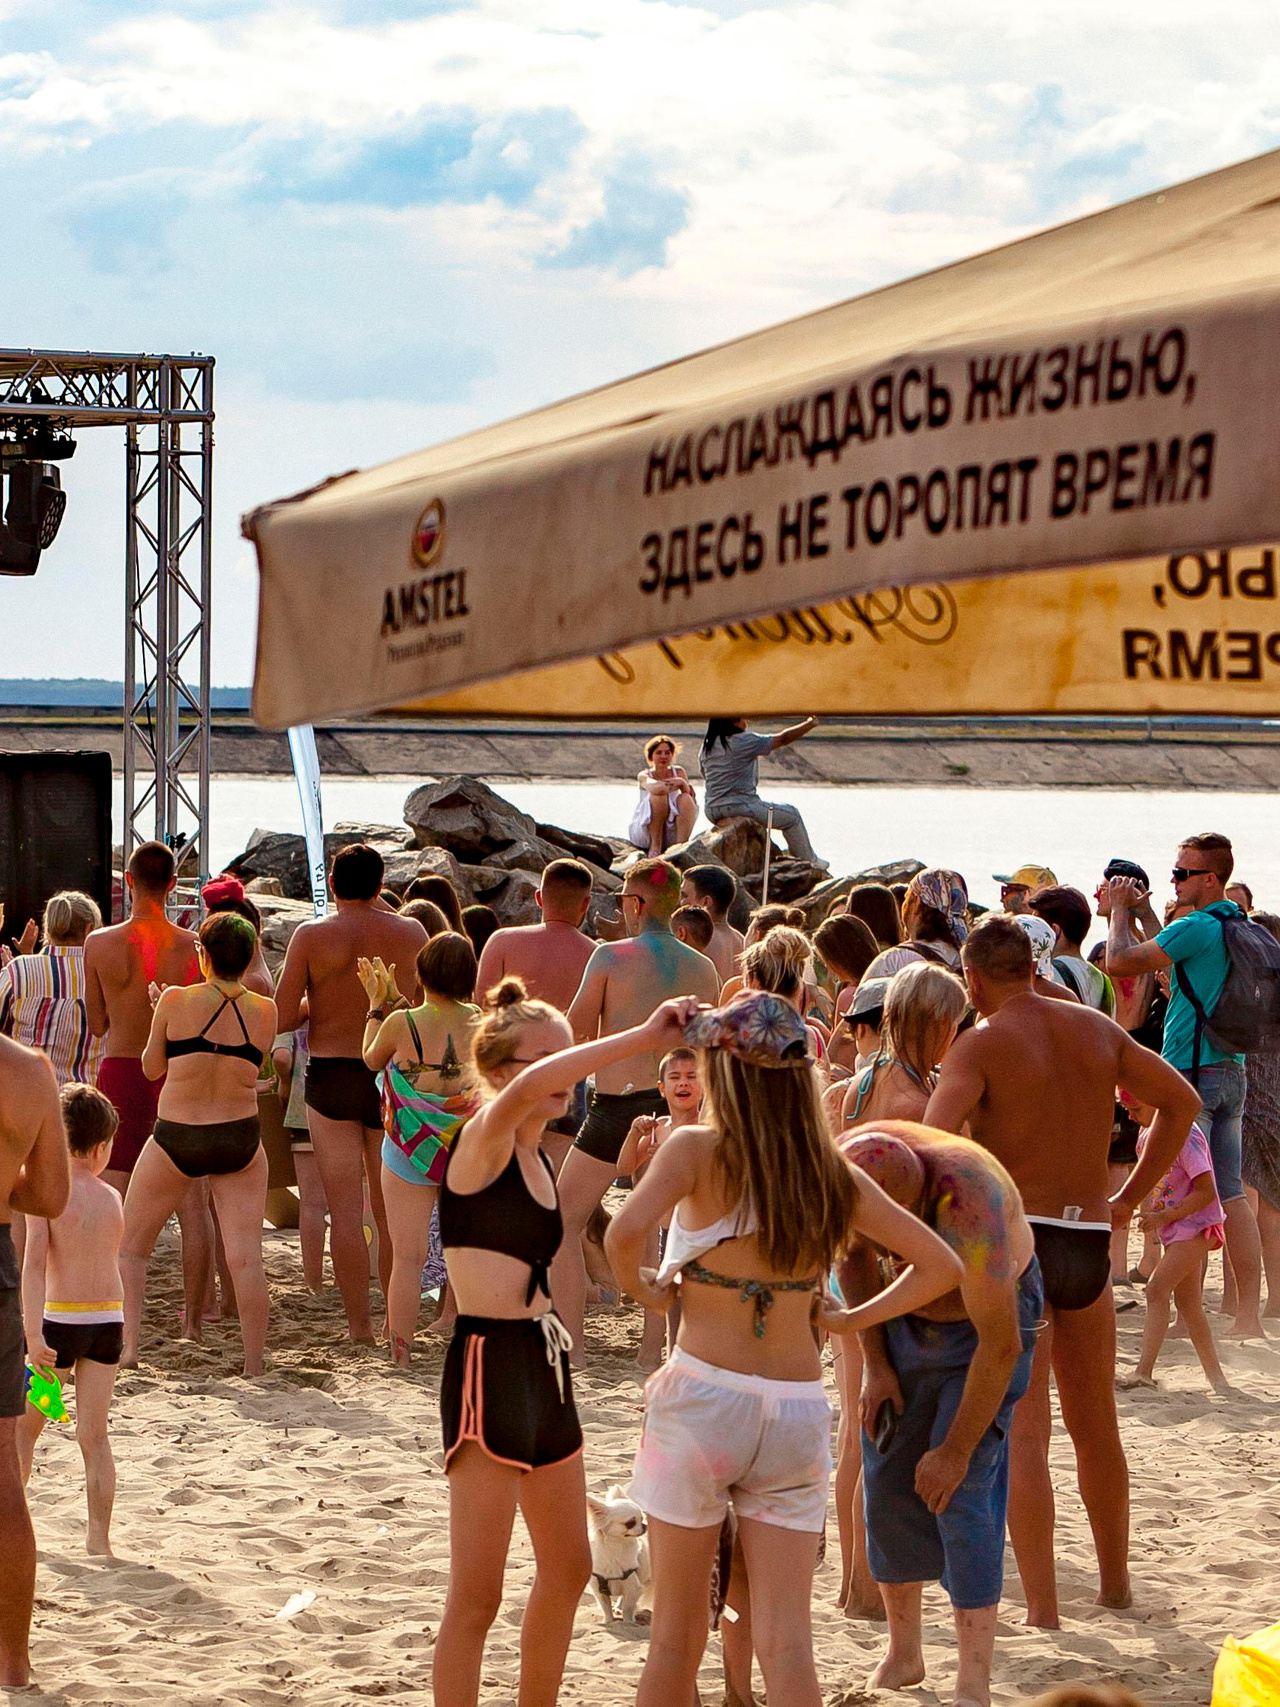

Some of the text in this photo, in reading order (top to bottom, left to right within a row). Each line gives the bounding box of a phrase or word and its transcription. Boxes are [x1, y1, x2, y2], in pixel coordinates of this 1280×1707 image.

[643, 327, 1199, 495] НАСЛАЖДАЯСЬ ЖИЗНЬЮ,
[638, 430, 1218, 603] ЗДЕСЬ НЕ ТОРОПЯТ ВРЕМЯ
[380, 567, 470, 638] AMSTEL
